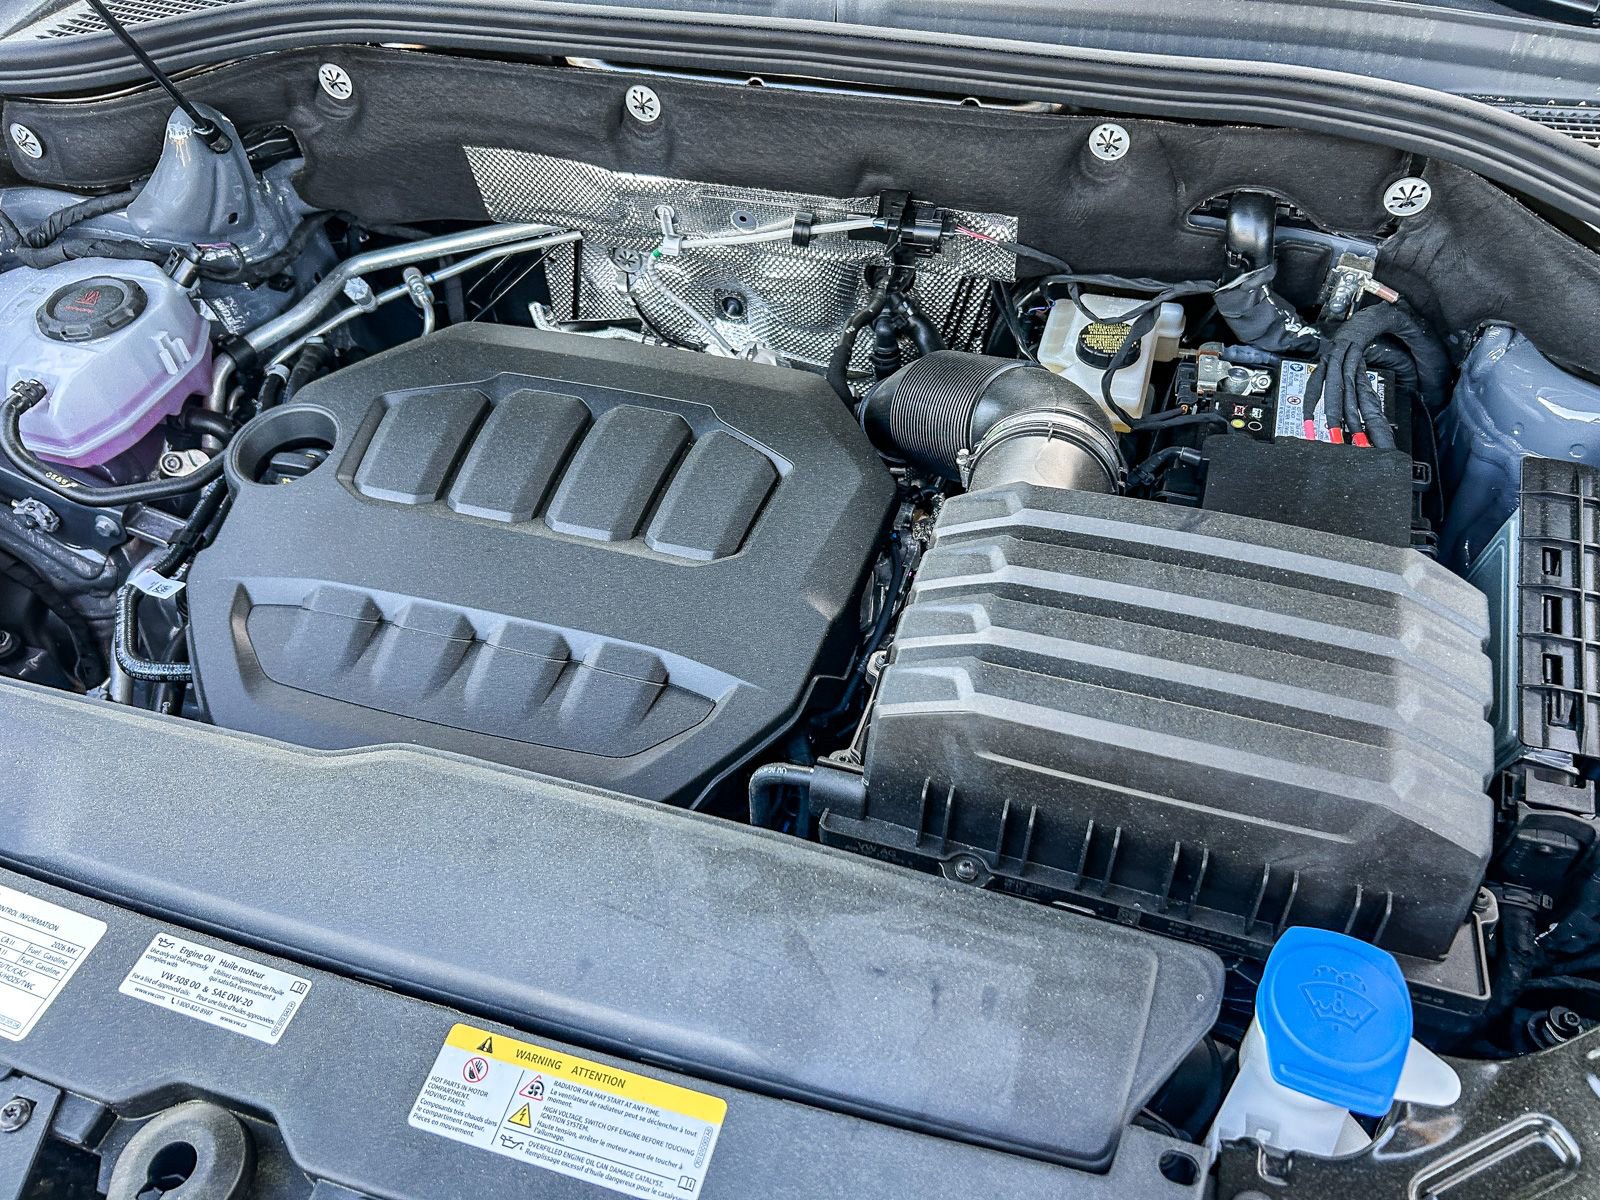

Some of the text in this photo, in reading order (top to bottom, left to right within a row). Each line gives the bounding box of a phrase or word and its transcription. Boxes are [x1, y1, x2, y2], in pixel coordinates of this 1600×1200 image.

[0, 905, 58, 931] NTROL INFORMATION
[51, 941, 77, 954] 2026 MY
[179, 946, 215, 962] Engine Oil
[43, 952, 68, 965] Gasoline
[145, 954, 166, 964] complies
[186, 960, 208, 971] expressly
[35, 962, 60, 976] Gasoline
[218, 959, 265, 979] Huile moteur
[213, 968, 232, 978] Utilisez
[231, 976, 262, 988] uniquement
[217, 978, 238, 988] satisfait
[157, 982, 181, 992] approved
[161, 971, 175, 981] VW
[174, 975, 190, 986] 508
[189, 980, 201, 989] 00
[211, 988, 227, 999] SAE
[227, 993, 253, 1007] 0W-20
[134, 987, 165, 1000] www.vw.com
[220, 1016, 247, 1028] www.vw.ca
[195, 993, 208, 1001] Pour
[217, 1000, 228, 1009] liste
[516, 1049, 626, 1088] WARNING ATTENTION
[427, 1082, 469, 1099] COMPARTMENT.
[443, 1079, 460, 1089] PARTS
[467, 1087, 488, 1097] MOTOR
[553, 1080, 581, 1093] RADIATOR
[581, 1088, 593, 1096] FAN
[594, 1092, 606, 1100] MAY
[607, 1096, 624, 1105] START
[424, 1089, 465, 1106] MOVING PARTS.
[412, 1112, 430, 1123] Pièces
[420, 1097, 453, 1113] Composants
[464, 1112, 483, 1122] chauds
[484, 1118, 497, 1127] dans
[422, 1108, 462, 1124] compartiment
[540, 1112, 565, 1124] IGNITION
[558, 1092, 589, 1104] ventilateur
[597, 1103, 624, 1115] radiateur
[623, 1111, 638, 1120] peut
[646, 1117, 678, 1131] déclencher
[684, 1128, 697, 1137] tout
[543, 1105, 558, 1114] HIGH
[584, 1117, 606, 1129] SWITCH
[606, 1124, 618, 1132] OFF
[618, 1128, 640, 1140] ENGINE
[641, 1135, 663, 1147] BEFORE
[665, 1142, 694, 1156] TOUCHING
[536, 1120, 554, 1130] Haute
[578, 1134, 599, 1144] arrêter
[606, 1142, 628, 1152] moteur
[628, 1149, 646, 1158] avant
[655, 1157, 678, 1168] toucher
[524, 1148, 560, 1164] Remplissage
[560, 1161, 584, 1171] excessif
[584, 1167, 604, 1178] d'huile
[604, 1174, 635, 1187] dangereux
[635, 1184, 650, 1192] pour
[528, 1140, 663, 1187] OVERFILLED ENGINE OIL CAN DAMAGE CATALYST.
